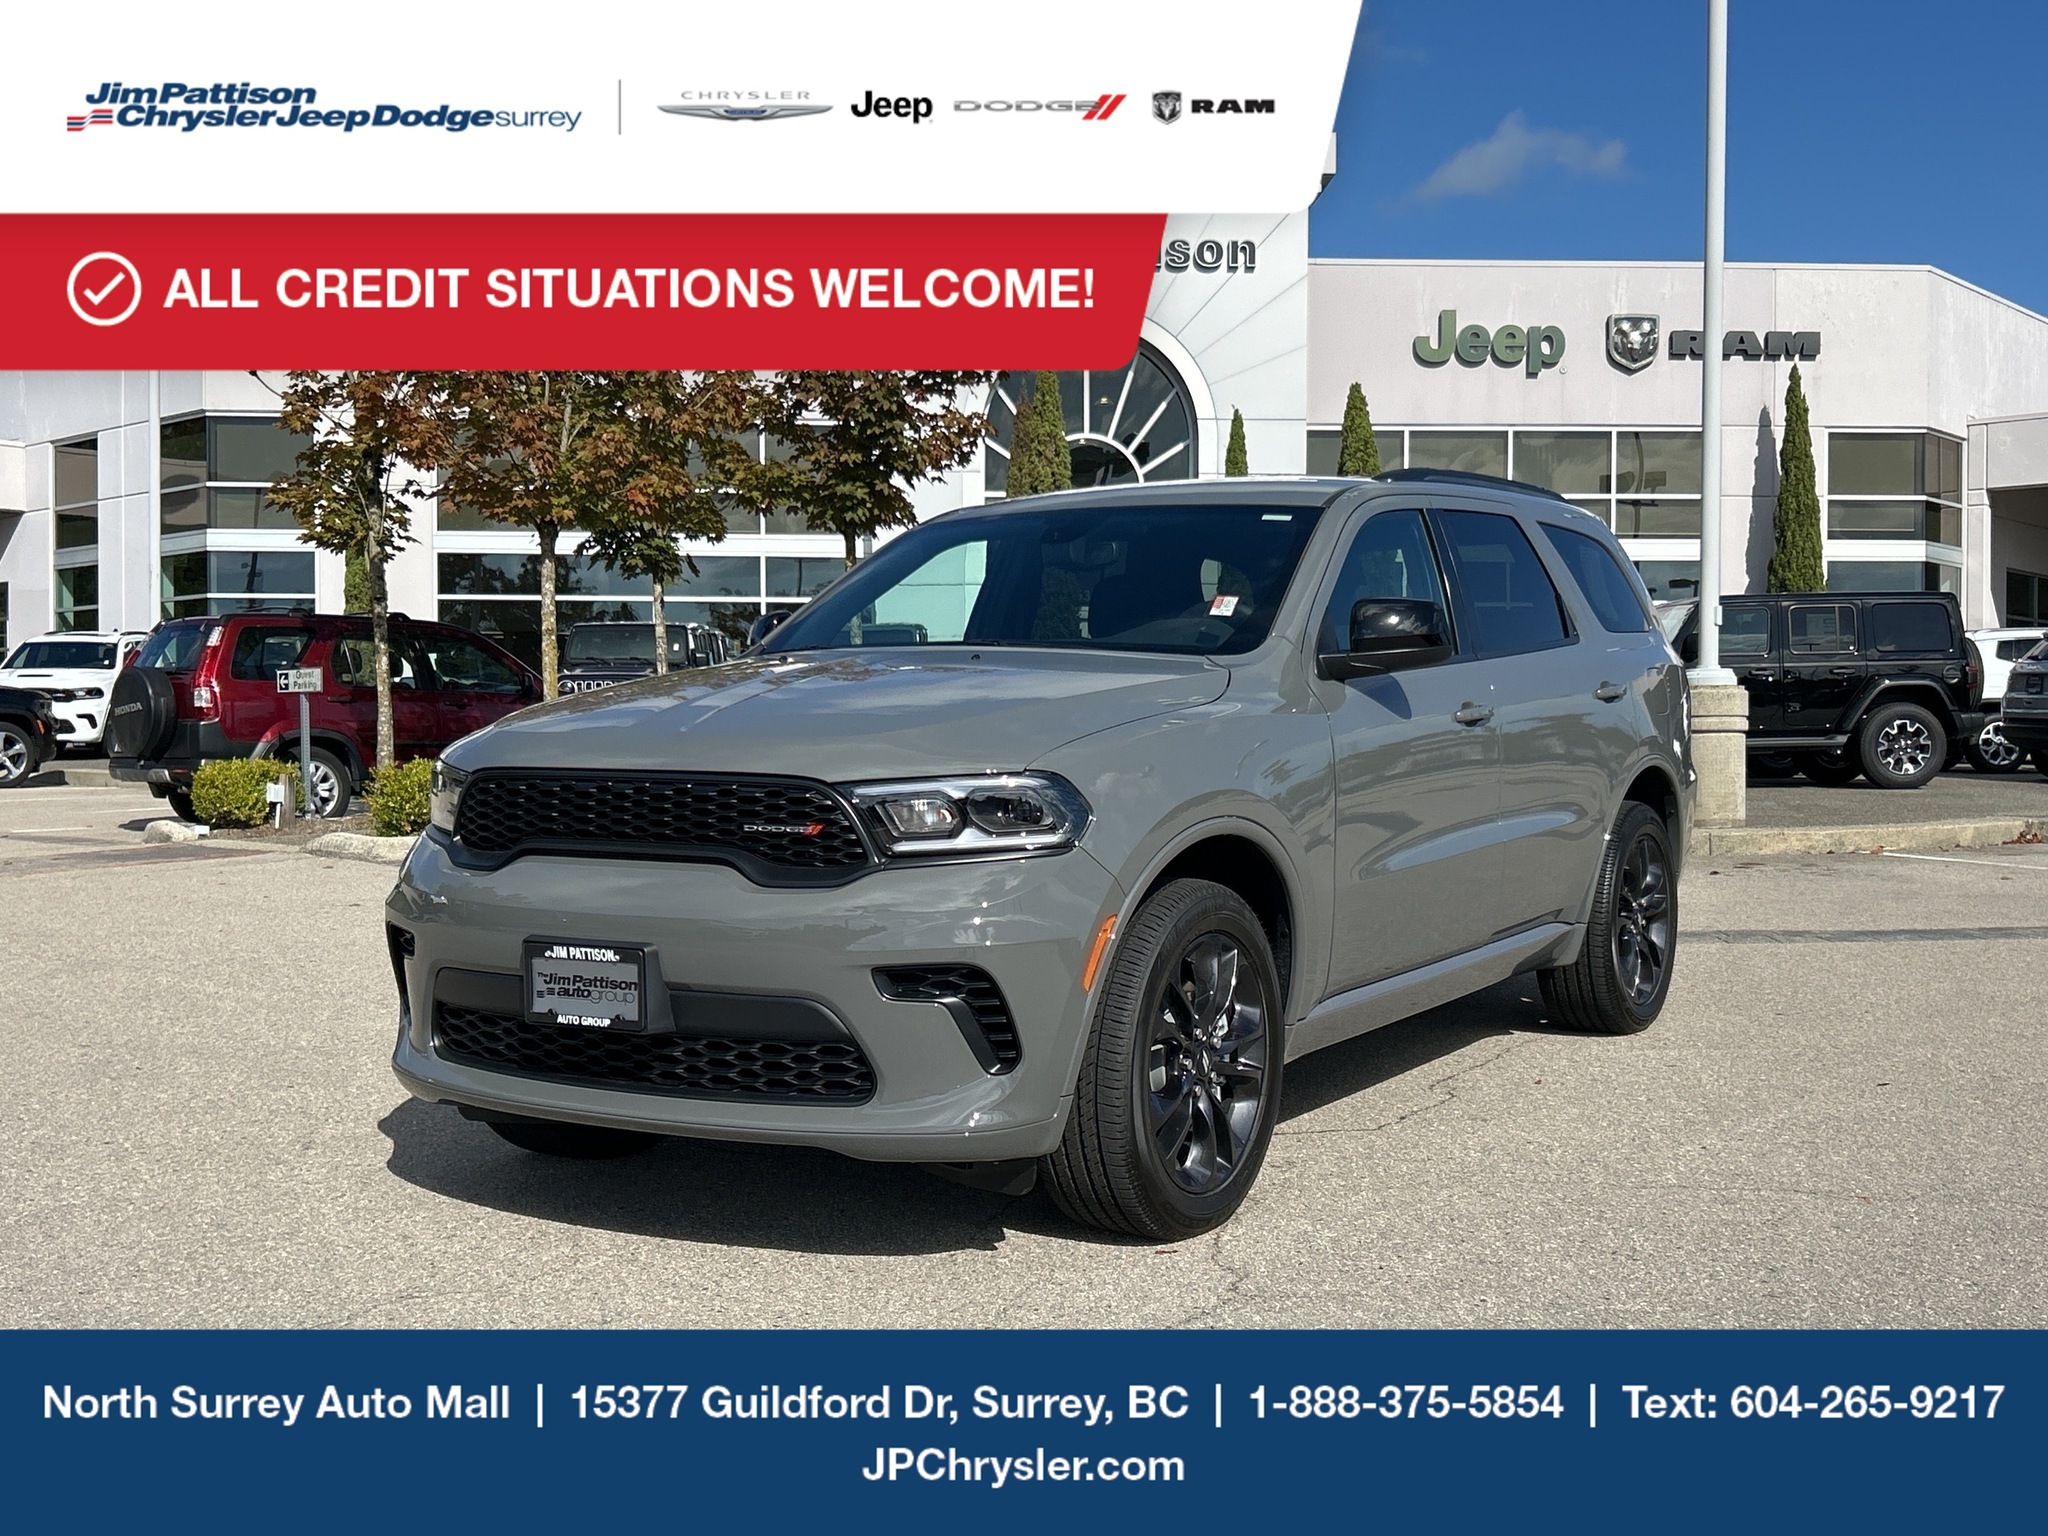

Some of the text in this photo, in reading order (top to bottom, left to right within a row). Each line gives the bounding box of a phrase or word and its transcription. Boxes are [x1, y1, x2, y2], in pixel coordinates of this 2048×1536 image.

[1154, 238, 1257, 274] son
[1413, 309, 1566, 379] Jeep
[1668, 330, 1822, 362] RAM
[293, 681, 317, 692] Parking
[114, 701, 144, 717] HONDA
[743, 824, 813, 834] DODGE
[551, 945, 615, 961] JIM PATTISON
[557, 1014, 611, 1027] AUTO GROUP
